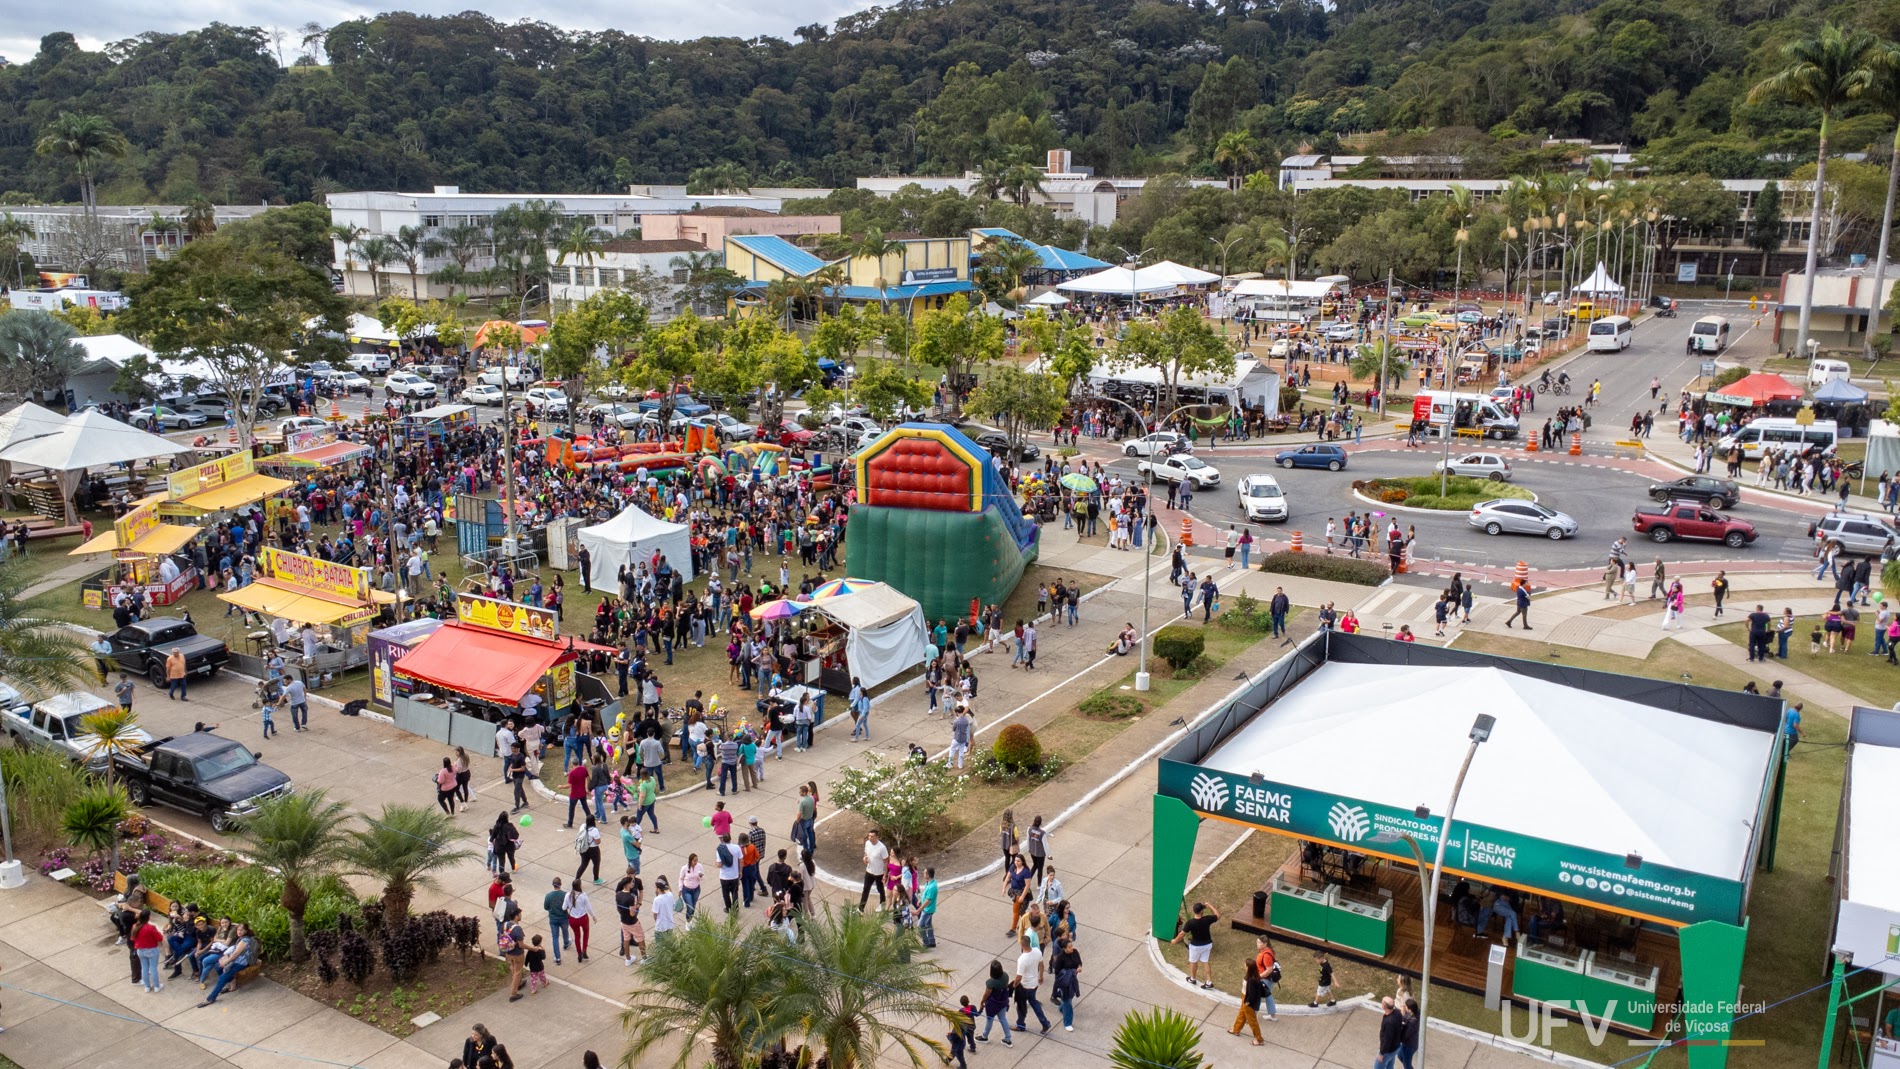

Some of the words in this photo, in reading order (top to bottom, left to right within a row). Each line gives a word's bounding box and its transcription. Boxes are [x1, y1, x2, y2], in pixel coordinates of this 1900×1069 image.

[200, 463, 220, 476] PIZZA
[276, 552, 314, 578] CHURROS
[323, 564, 354, 588] BATATA
[342, 604, 378, 622] CHURROS
[1235, 784, 1292, 809] FAEMG
[1235, 800, 1290, 824] SENAR
[1374, 813, 1419, 829] SINDICATO
[1420, 823, 1438, 833] DOS
[1430, 835, 1461, 848] RUAIS
[1470, 839, 1516, 858] FAEMG
[1469, 850, 1513, 869] SENAR
[1560, 860, 1696, 898] www.sistemafaemg.org.br
[1626, 888, 1695, 911] @sistemafaemg
